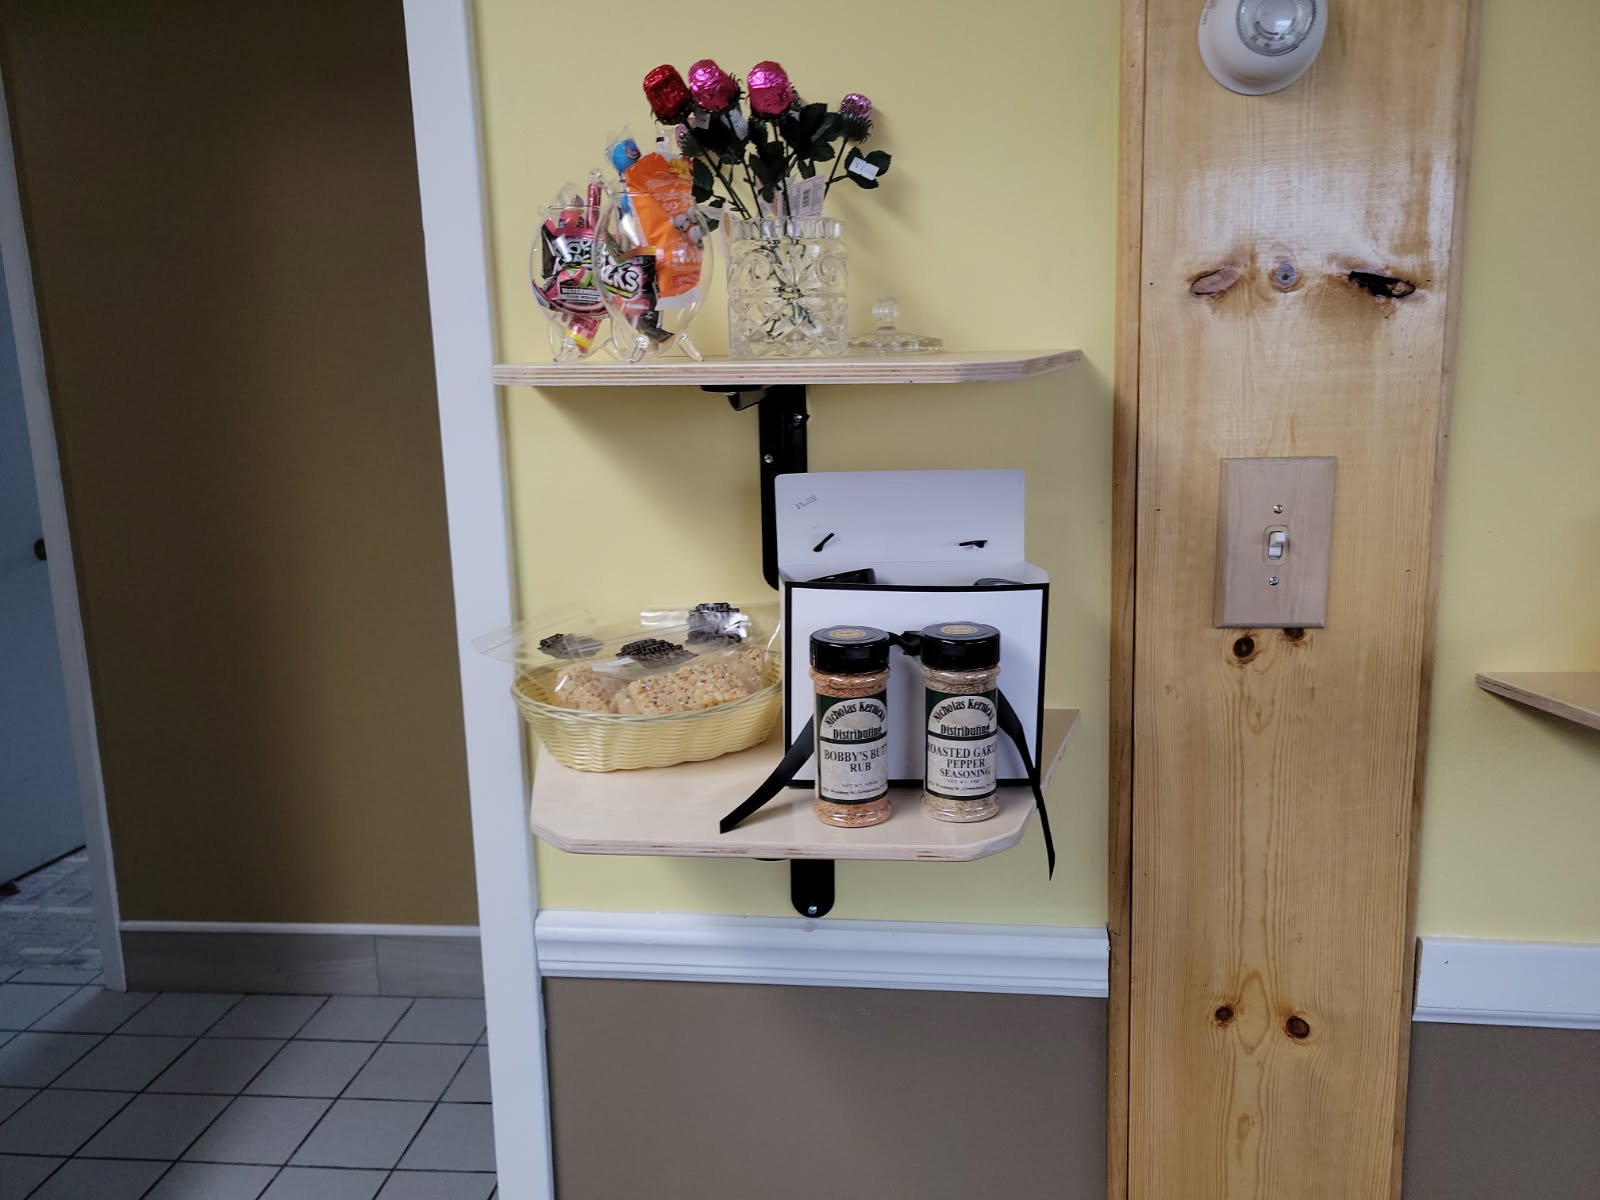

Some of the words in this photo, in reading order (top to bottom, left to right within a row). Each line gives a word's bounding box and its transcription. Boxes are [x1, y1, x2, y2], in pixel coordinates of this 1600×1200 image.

[825, 703, 857, 727] Nicholas
[933, 701, 965, 722] Nicholas
[824, 749, 869, 762] BOBBY'S
[850, 762, 871, 773] RUB
[946, 758, 985, 769] PEPPER
[940, 767, 990, 779] SEASONING
